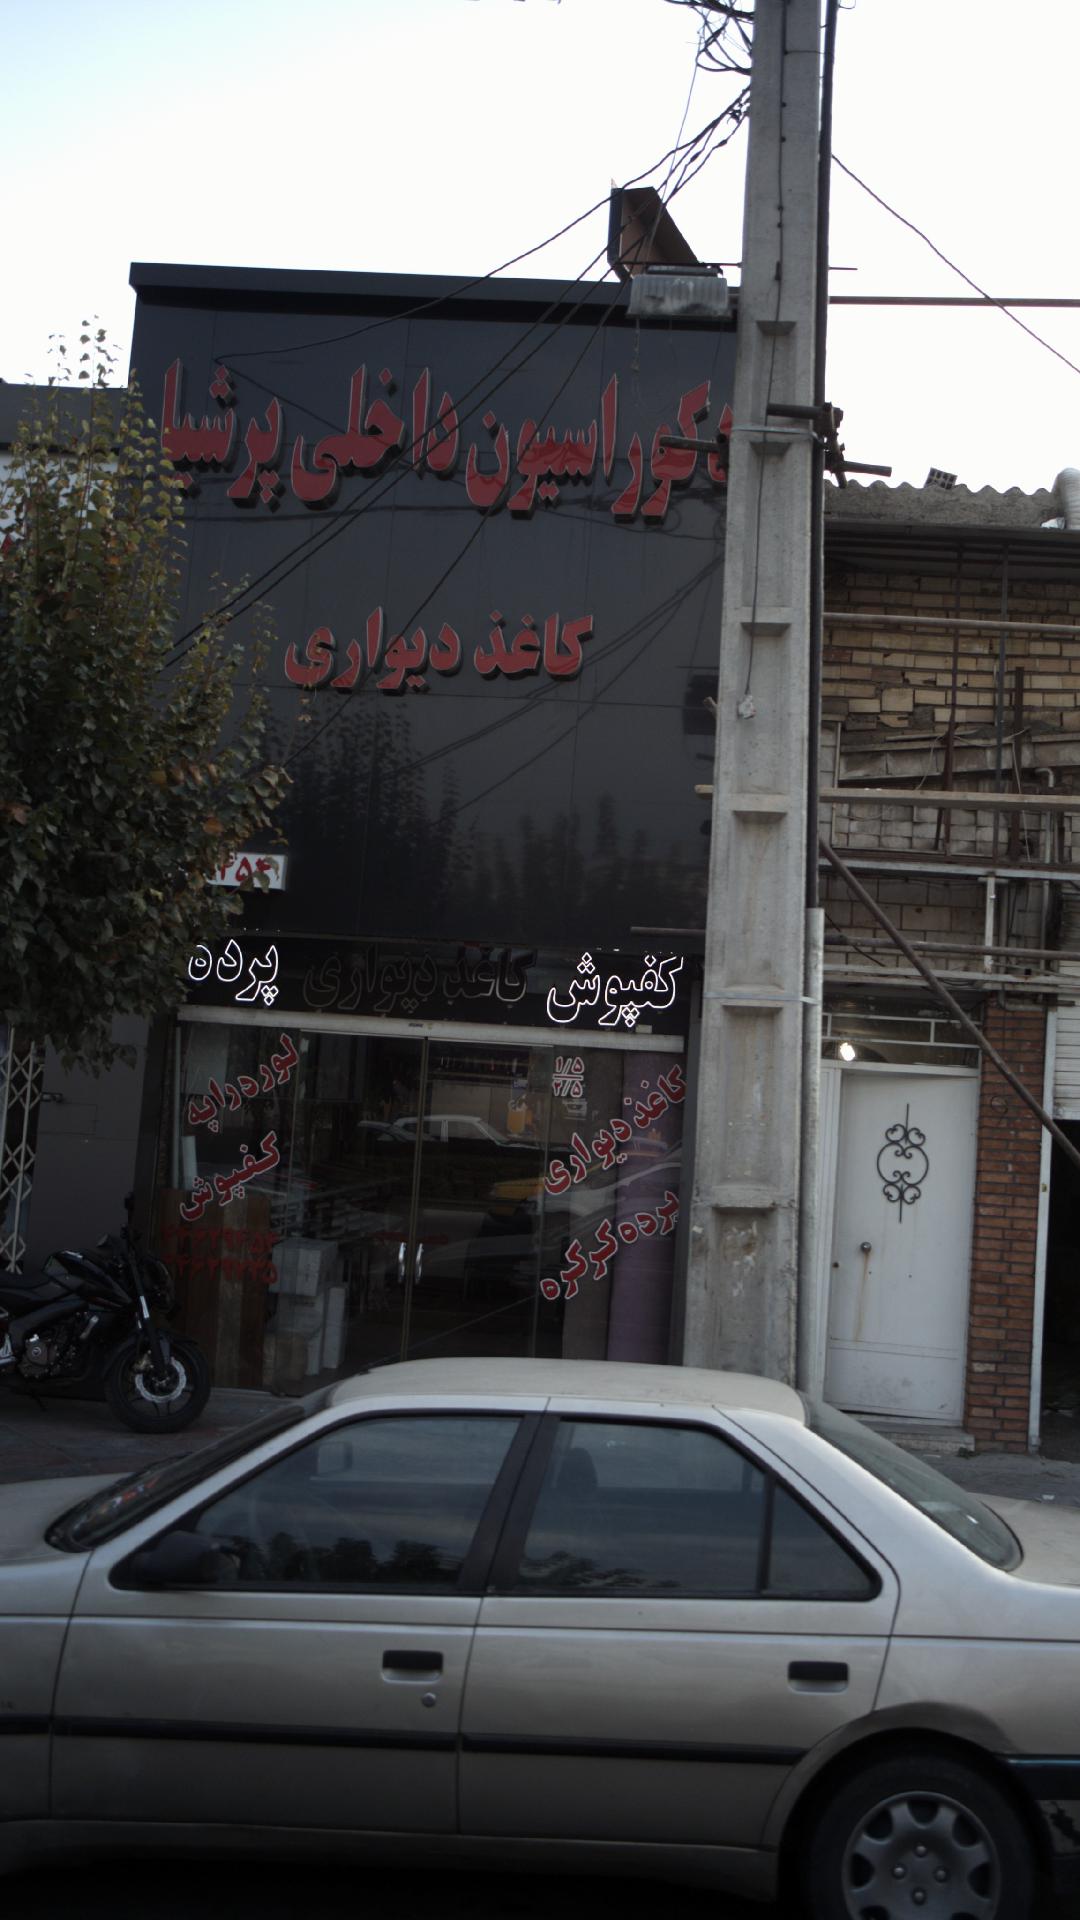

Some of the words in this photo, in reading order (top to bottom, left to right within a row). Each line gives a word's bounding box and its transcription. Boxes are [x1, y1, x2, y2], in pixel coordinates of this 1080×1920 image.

[161, 356, 283, 503] پرشیا
[291, 363, 460, 502] داخلی
[284, 606, 463, 691] دیواری
[473, 609, 594, 676] کاغذ
[188, 938, 279, 1007] پرده
[302, 943, 438, 1013] دیواری
[546, 951, 684, 1027] کفپوش
[624, 1063, 687, 1130] کاغذ
[179, 1130, 282, 1222] کفپوش
[544, 1118, 632, 1195] دیواری
[540, 1218, 618, 1300] کرکره
